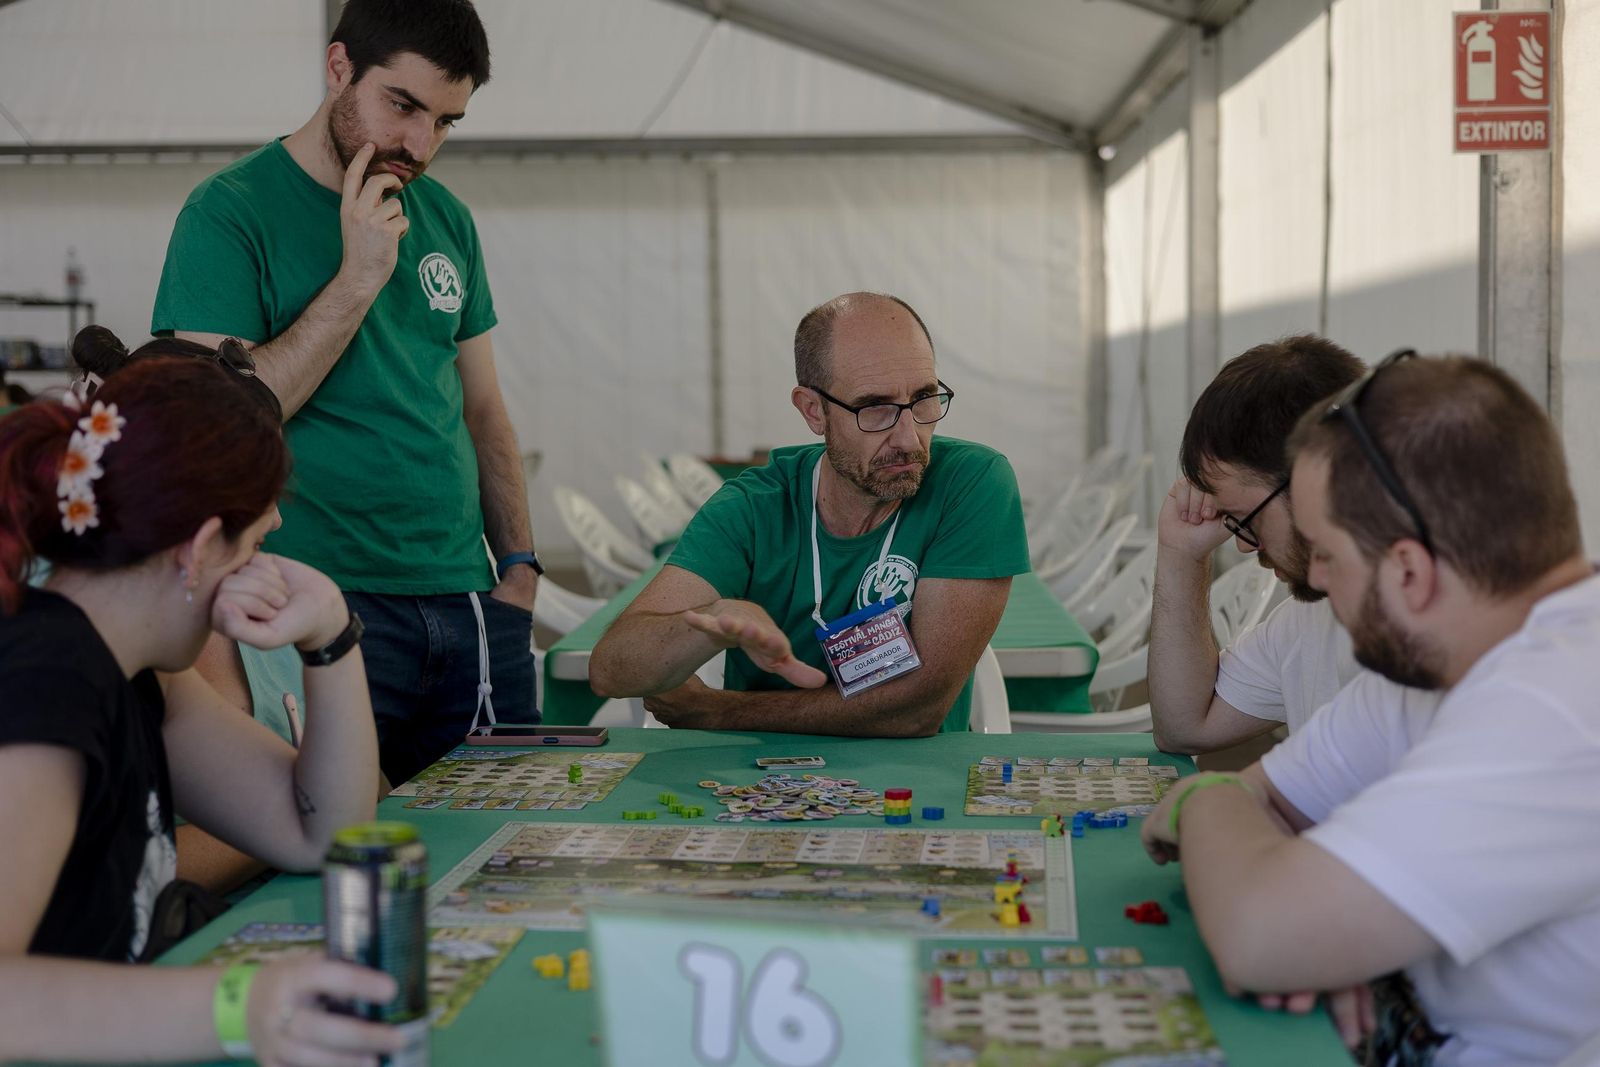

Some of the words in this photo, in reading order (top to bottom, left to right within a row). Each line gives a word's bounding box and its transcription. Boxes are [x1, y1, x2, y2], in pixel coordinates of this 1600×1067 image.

[1459, 120, 1546, 143] EXTINTOR
[828, 631, 867, 654] FESTIVAL
[867, 616, 898, 636] MANGA
[836, 647, 856, 662] 2025
[872, 626, 903, 646] CÁDIZ
[854, 645, 902, 671] COLABORADOR
[677, 941, 844, 1067] 16
